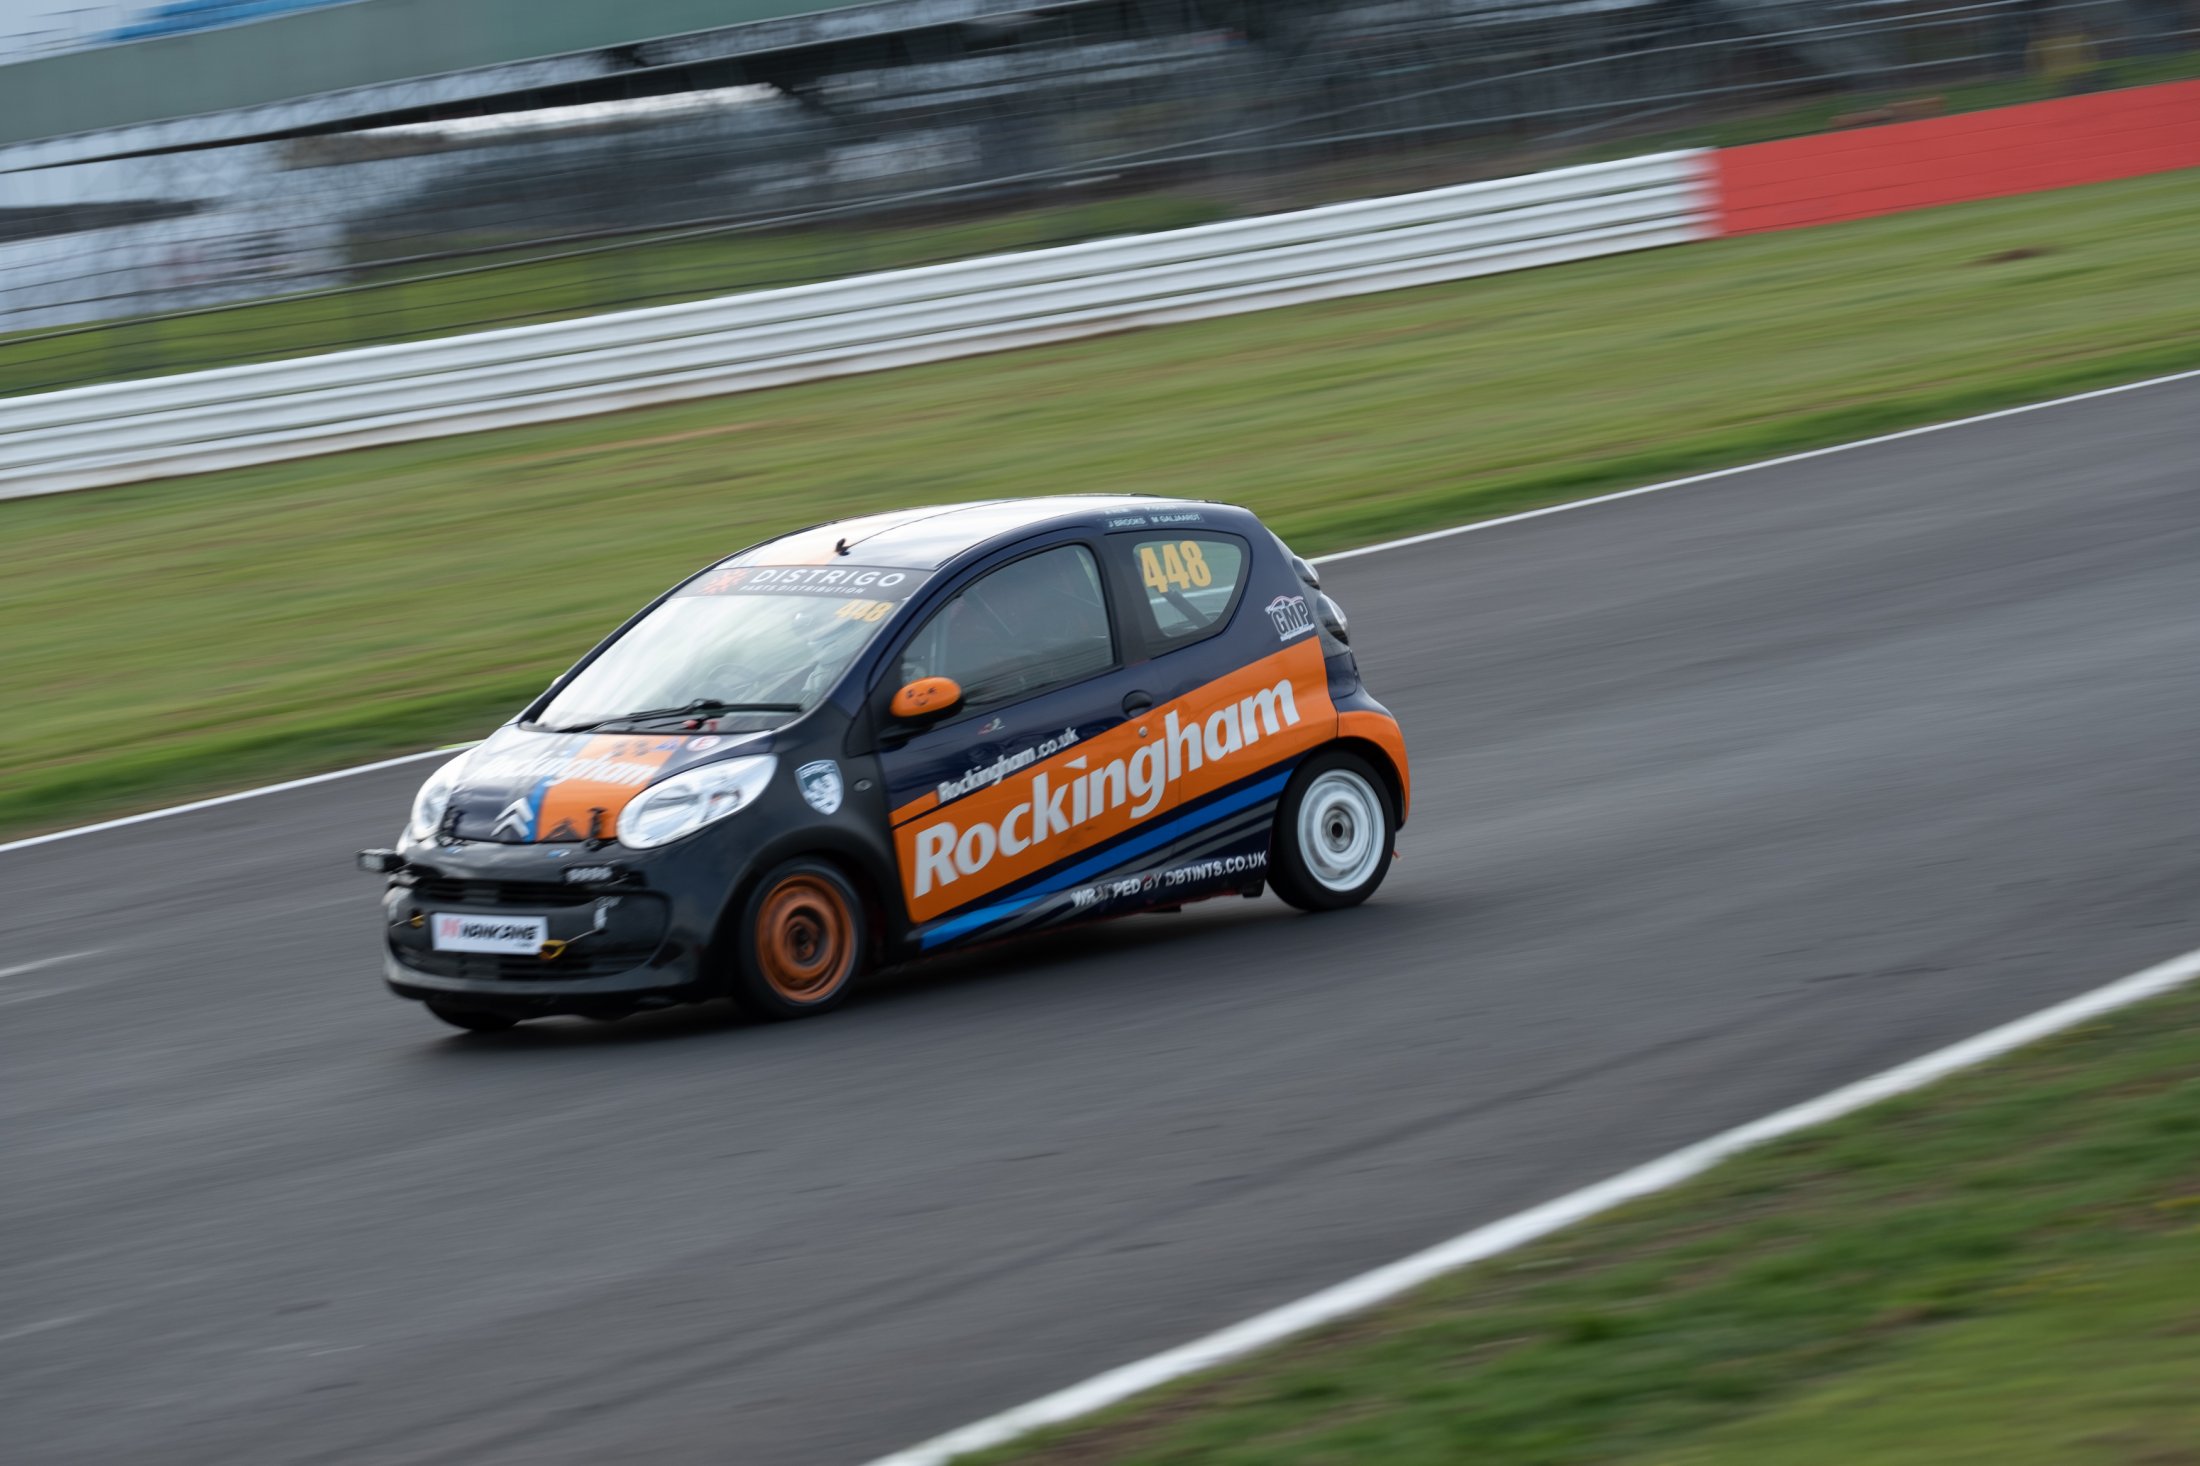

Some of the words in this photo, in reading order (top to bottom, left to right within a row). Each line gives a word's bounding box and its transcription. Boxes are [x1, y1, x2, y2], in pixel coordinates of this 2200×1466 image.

[750, 569, 906, 588] DISTRIGO
[1139, 540, 1212, 594] 448
[1271, 601, 1309, 636] GMP
[937, 727, 1080, 803] Rockingham.co.uk
[913, 679, 1300, 898] Rockingham
[1165, 850, 1267, 887] DBTINTS.CO.UK
